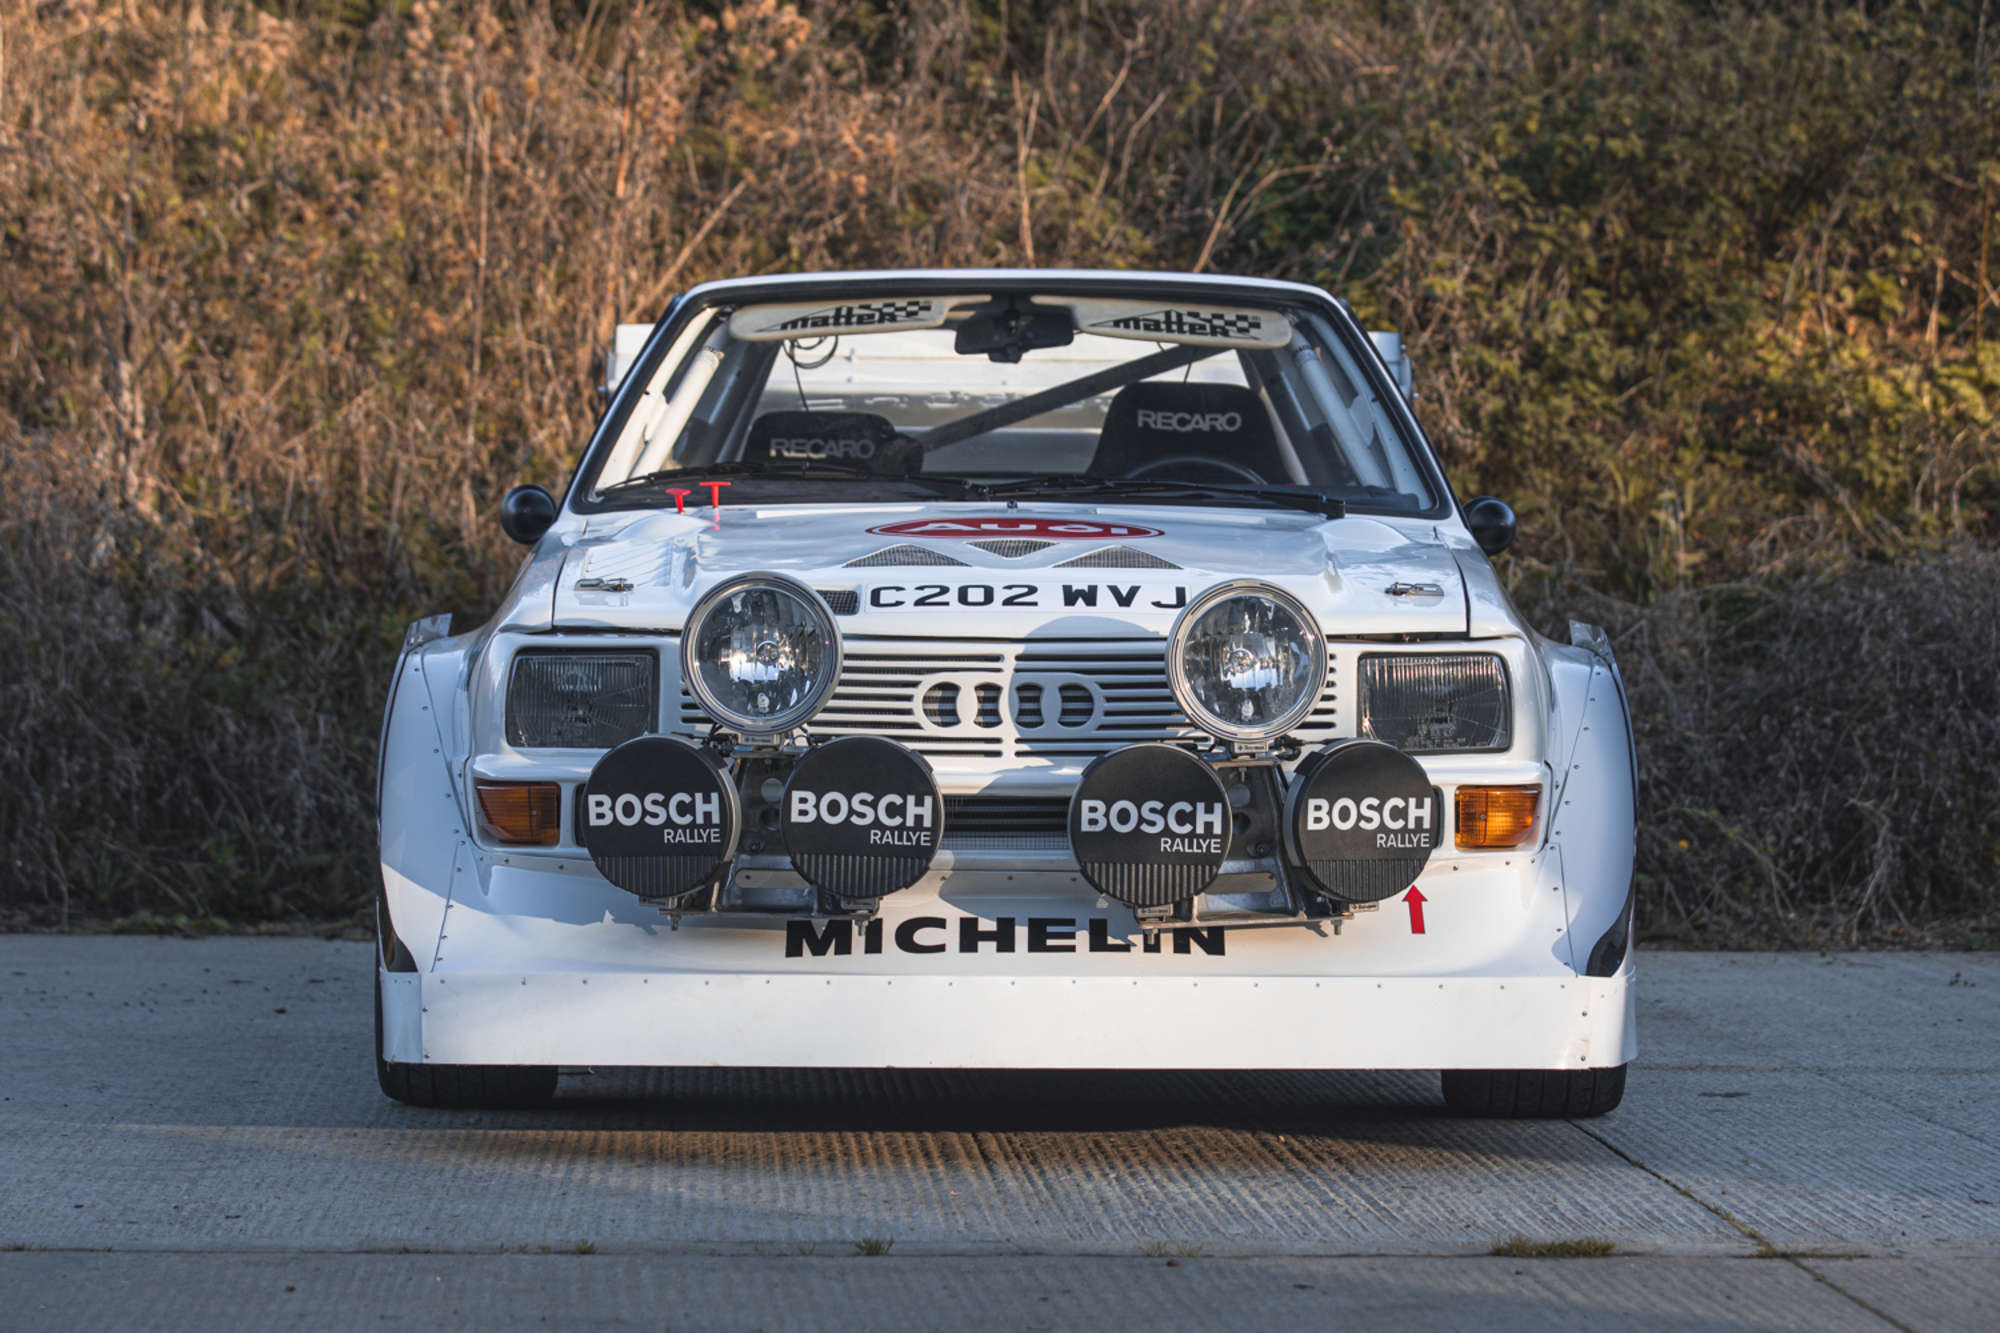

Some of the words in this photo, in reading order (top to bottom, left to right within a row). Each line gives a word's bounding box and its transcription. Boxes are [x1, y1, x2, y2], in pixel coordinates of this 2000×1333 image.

[1137, 409, 1243, 433] RECARO
[769, 437, 875, 460] RECARO
[869, 583, 1039, 608] C202
[1062, 583, 1188, 609] WVJ
[587, 791, 721, 827] BOSCH
[790, 789, 933, 828] BOSCH
[1080, 799, 1223, 836] BOSCH
[1306, 796, 1432, 831] BOSCH
[663, 827, 722, 844] RALLYE
[869, 829, 932, 847] RALLYE
[1160, 836, 1222, 854] RALLYE
[1376, 832, 1431, 849] RALLYE
